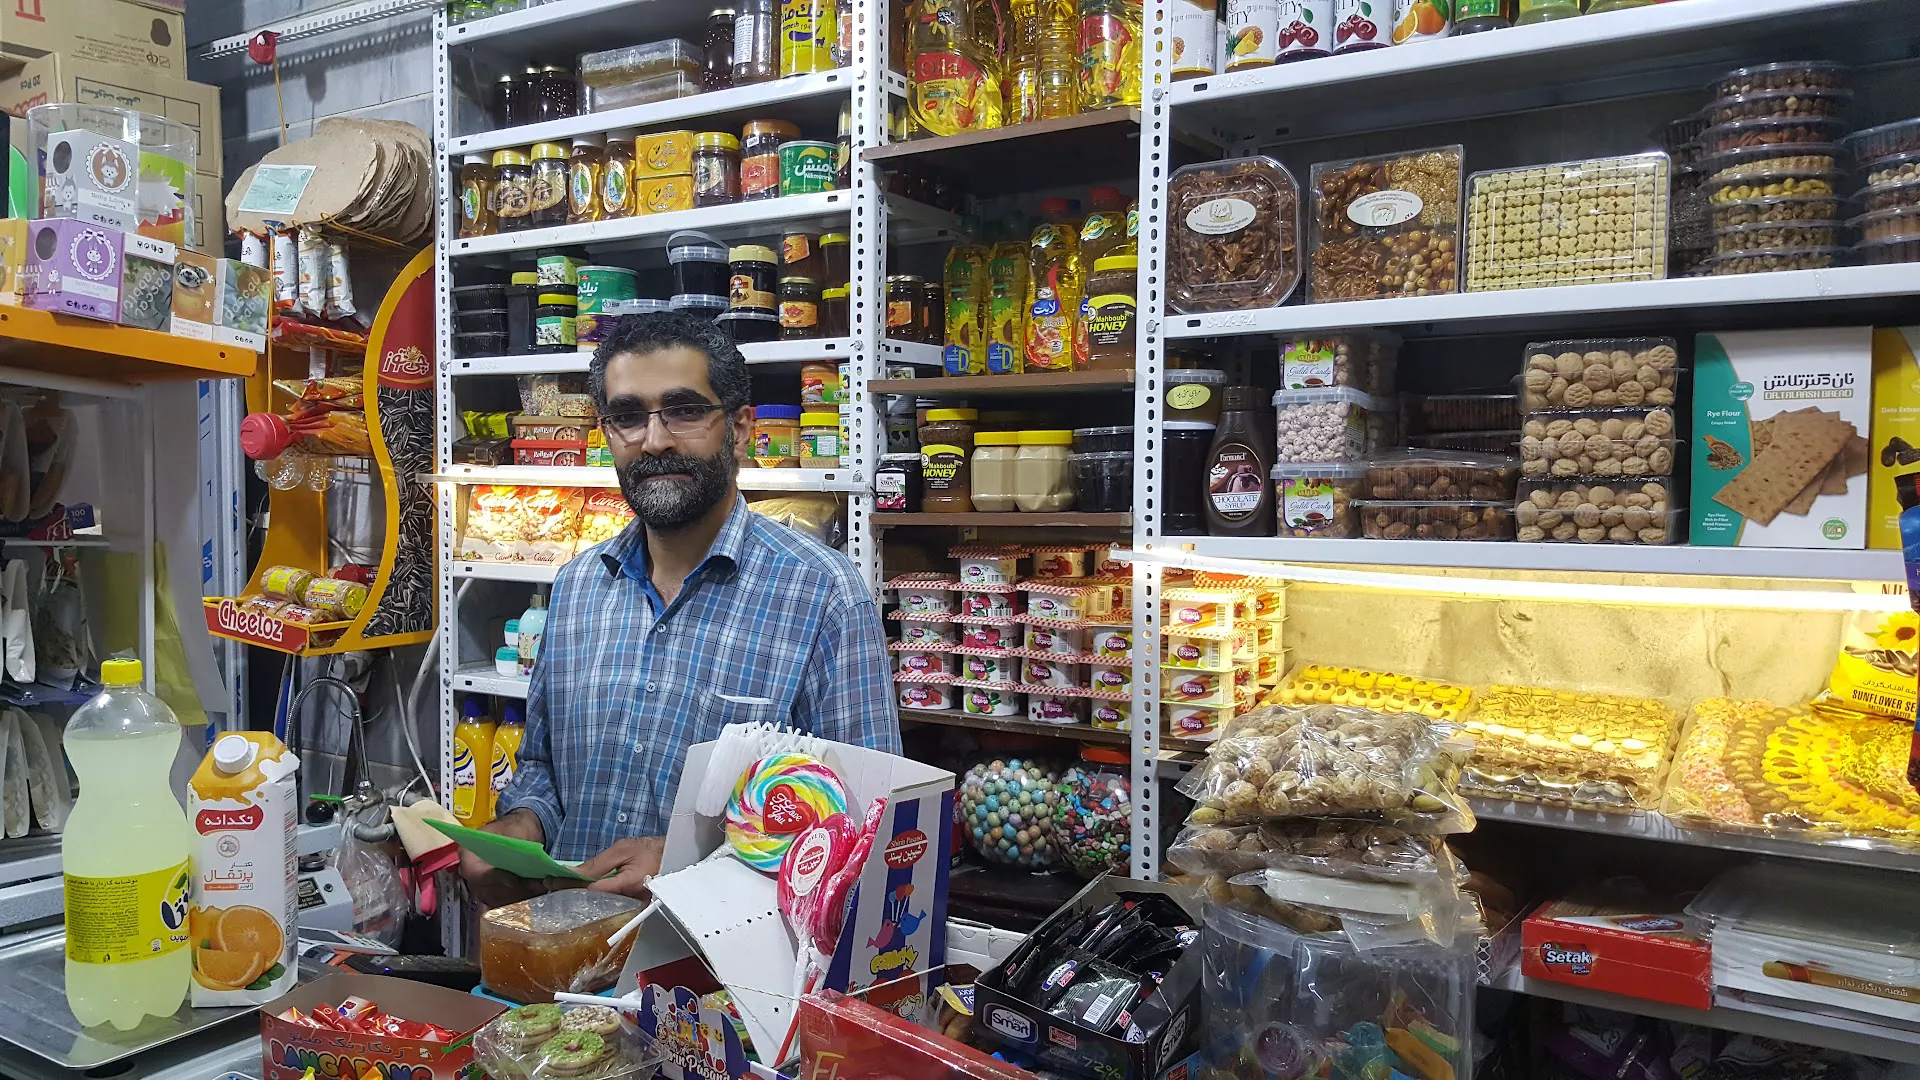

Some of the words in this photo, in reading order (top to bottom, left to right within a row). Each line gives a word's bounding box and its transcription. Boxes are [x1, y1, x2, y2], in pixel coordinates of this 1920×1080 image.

[1033, 300, 1056, 314] لایت
[1096, 314, 1127, 323] Mahboubi
[1089, 321, 1127, 333] HONEY
[1310, 366, 1331, 377] Candy
[1833, 373, 1854, 390] نان
[1707, 410, 1721, 418] Rye
[923, 468, 957, 478] HONEY
[588, 492, 632, 517] Candy
[1214, 494, 1258, 504] CHOCOLATE
[1310, 501, 1331, 512] Candy
[71, 509, 86, 517] 100
[218, 599, 284, 642] Cheetoz
[1852, 689, 1902, 709] SUNFLOWER
[205, 814, 254, 826] تکدانه
[204, 869, 253, 882] پرتقال
[1546, 950, 1591, 964] Setak
[1857, 983, 1881, 993] دیگری
[1885, 987, 1908, 997] شعبه
[992, 1012, 1029, 1036] Smart
[1081, 1055, 1121, 1080] 72%
